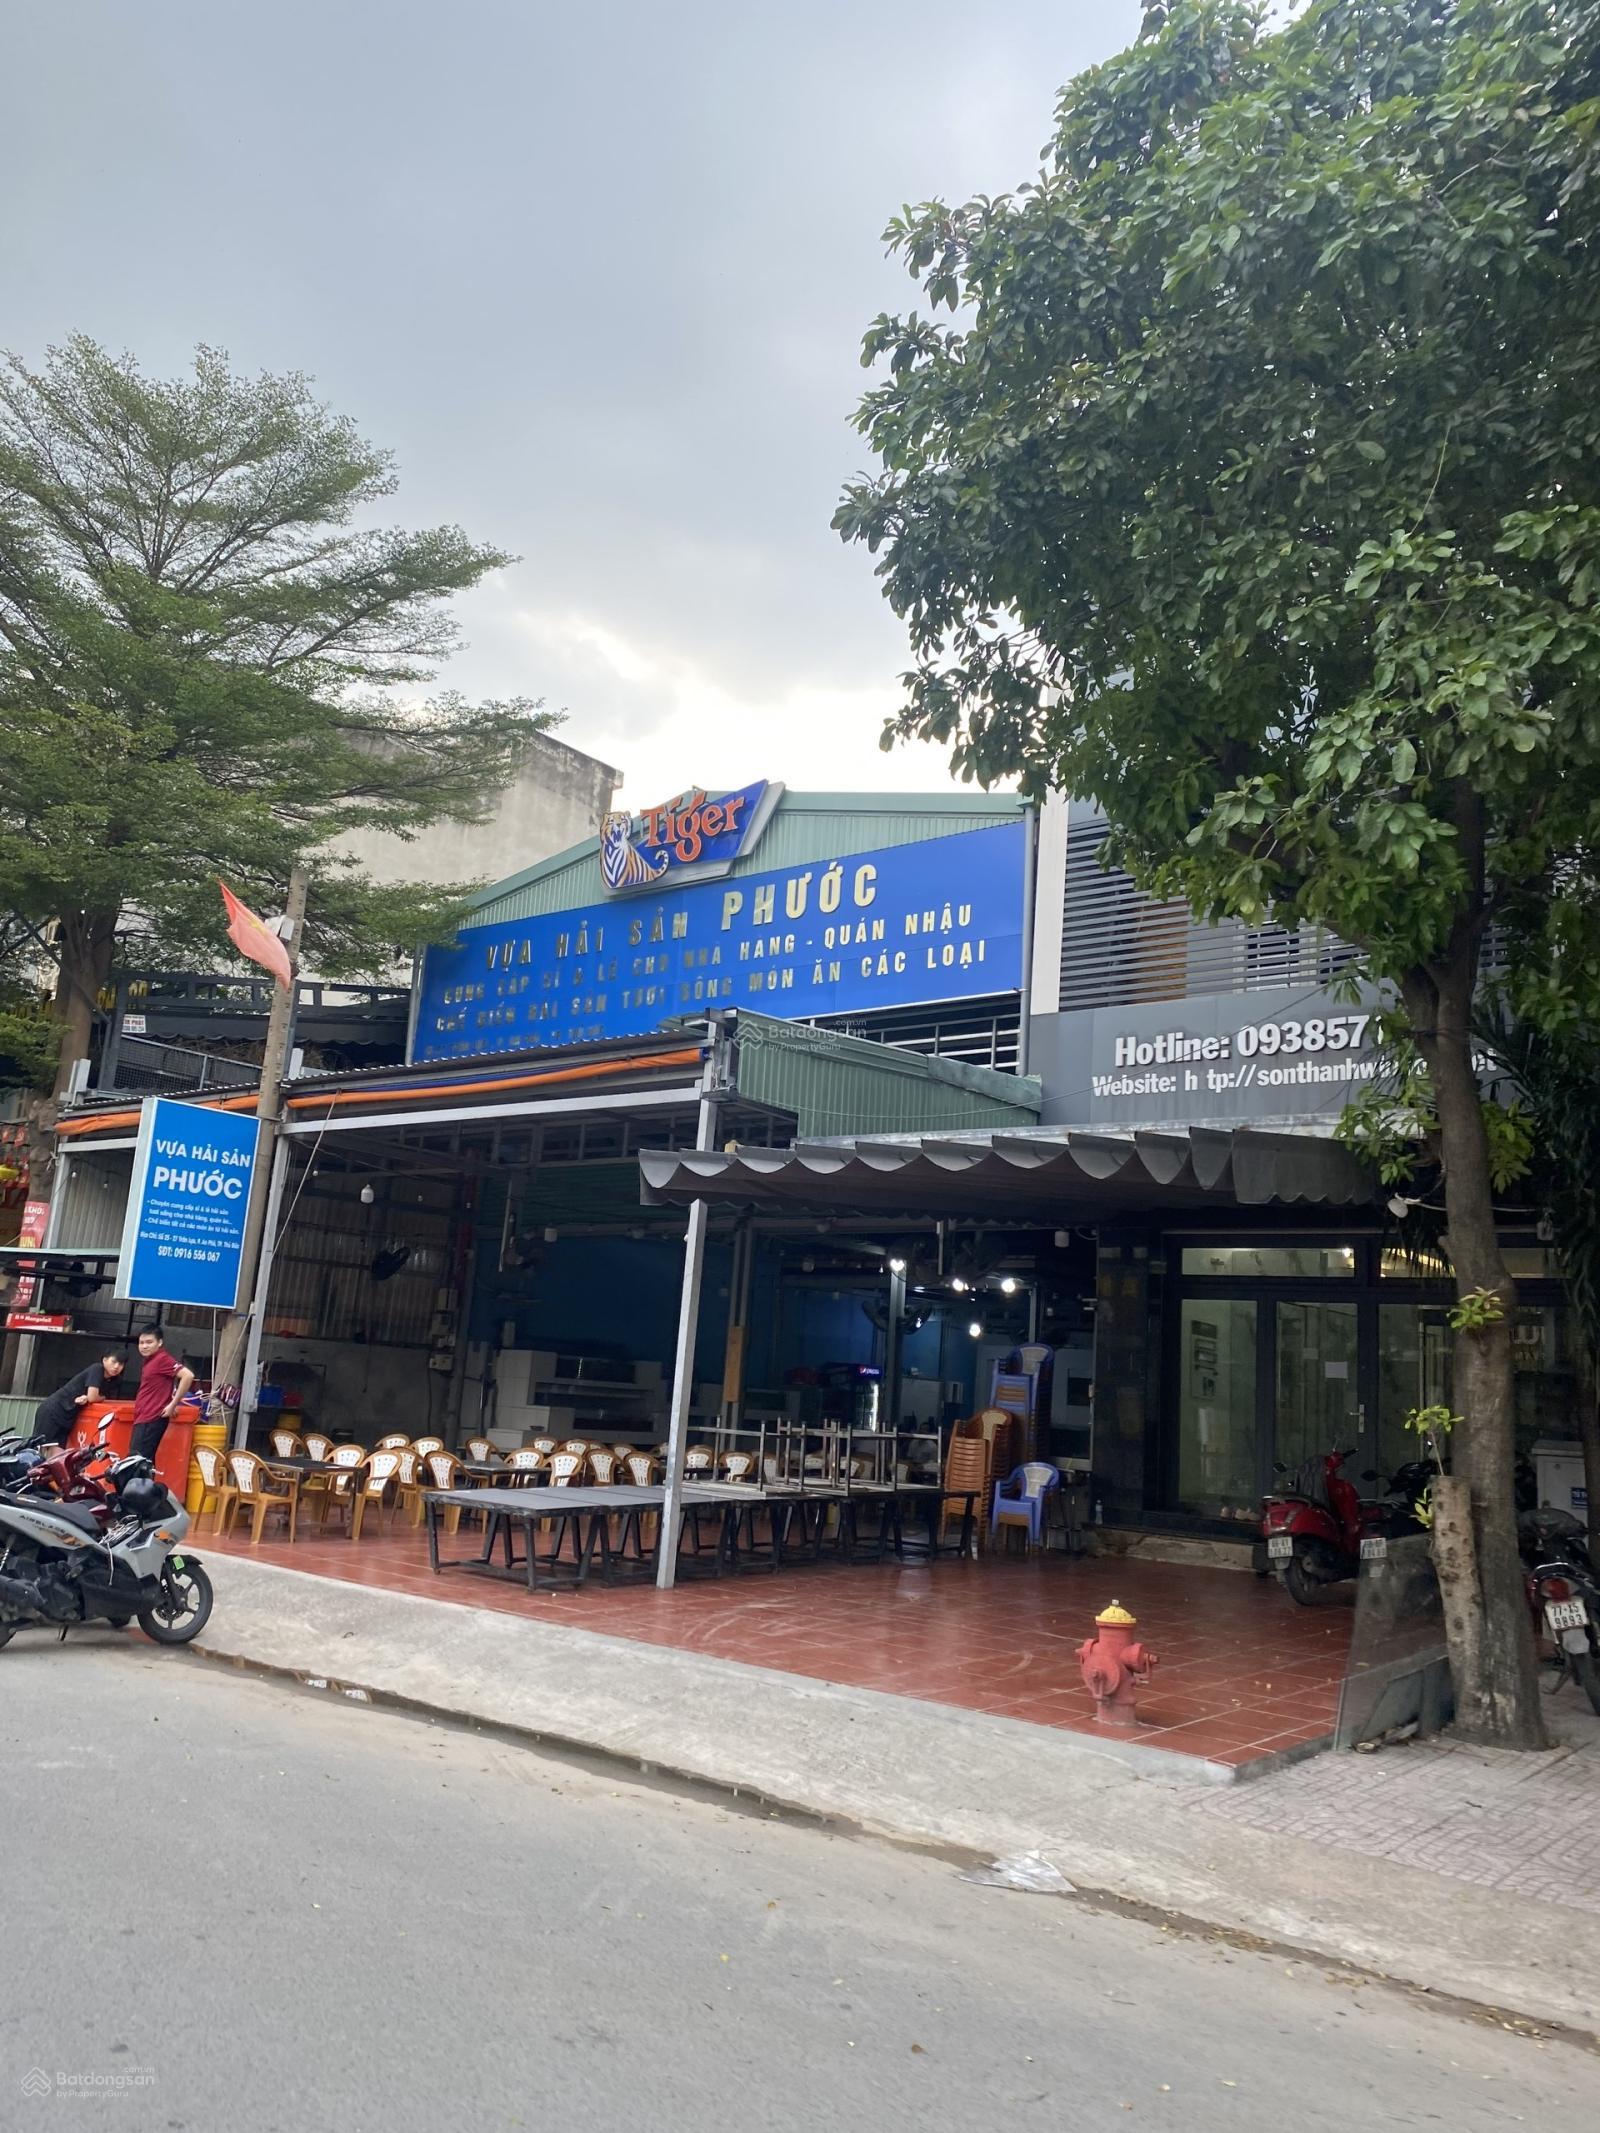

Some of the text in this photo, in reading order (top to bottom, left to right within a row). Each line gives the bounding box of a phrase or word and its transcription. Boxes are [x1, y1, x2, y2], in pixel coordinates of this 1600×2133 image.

[640, 791, 745, 862] Tiger
[487, 862, 877, 972] VỰA HẢI SẢN PHƯỚC
[824, 917, 885, 949] QUÁN
[905, 902, 971, 934] NHẬU
[749, 965, 794, 992] MÓN
[813, 959, 841, 985] ĂN
[861, 949, 906, 978] CÁC
[927, 940, 986, 969] LOẠI
[1115, 1032, 1231, 1067] Hotline:
[1092, 1073, 1177, 1097] Website:
[156, 1139, 250, 1168] VỰA HẢI SẢN
[153, 1166, 243, 1200] PHƯỚC
[173, 1247, 192, 1259] 0916
